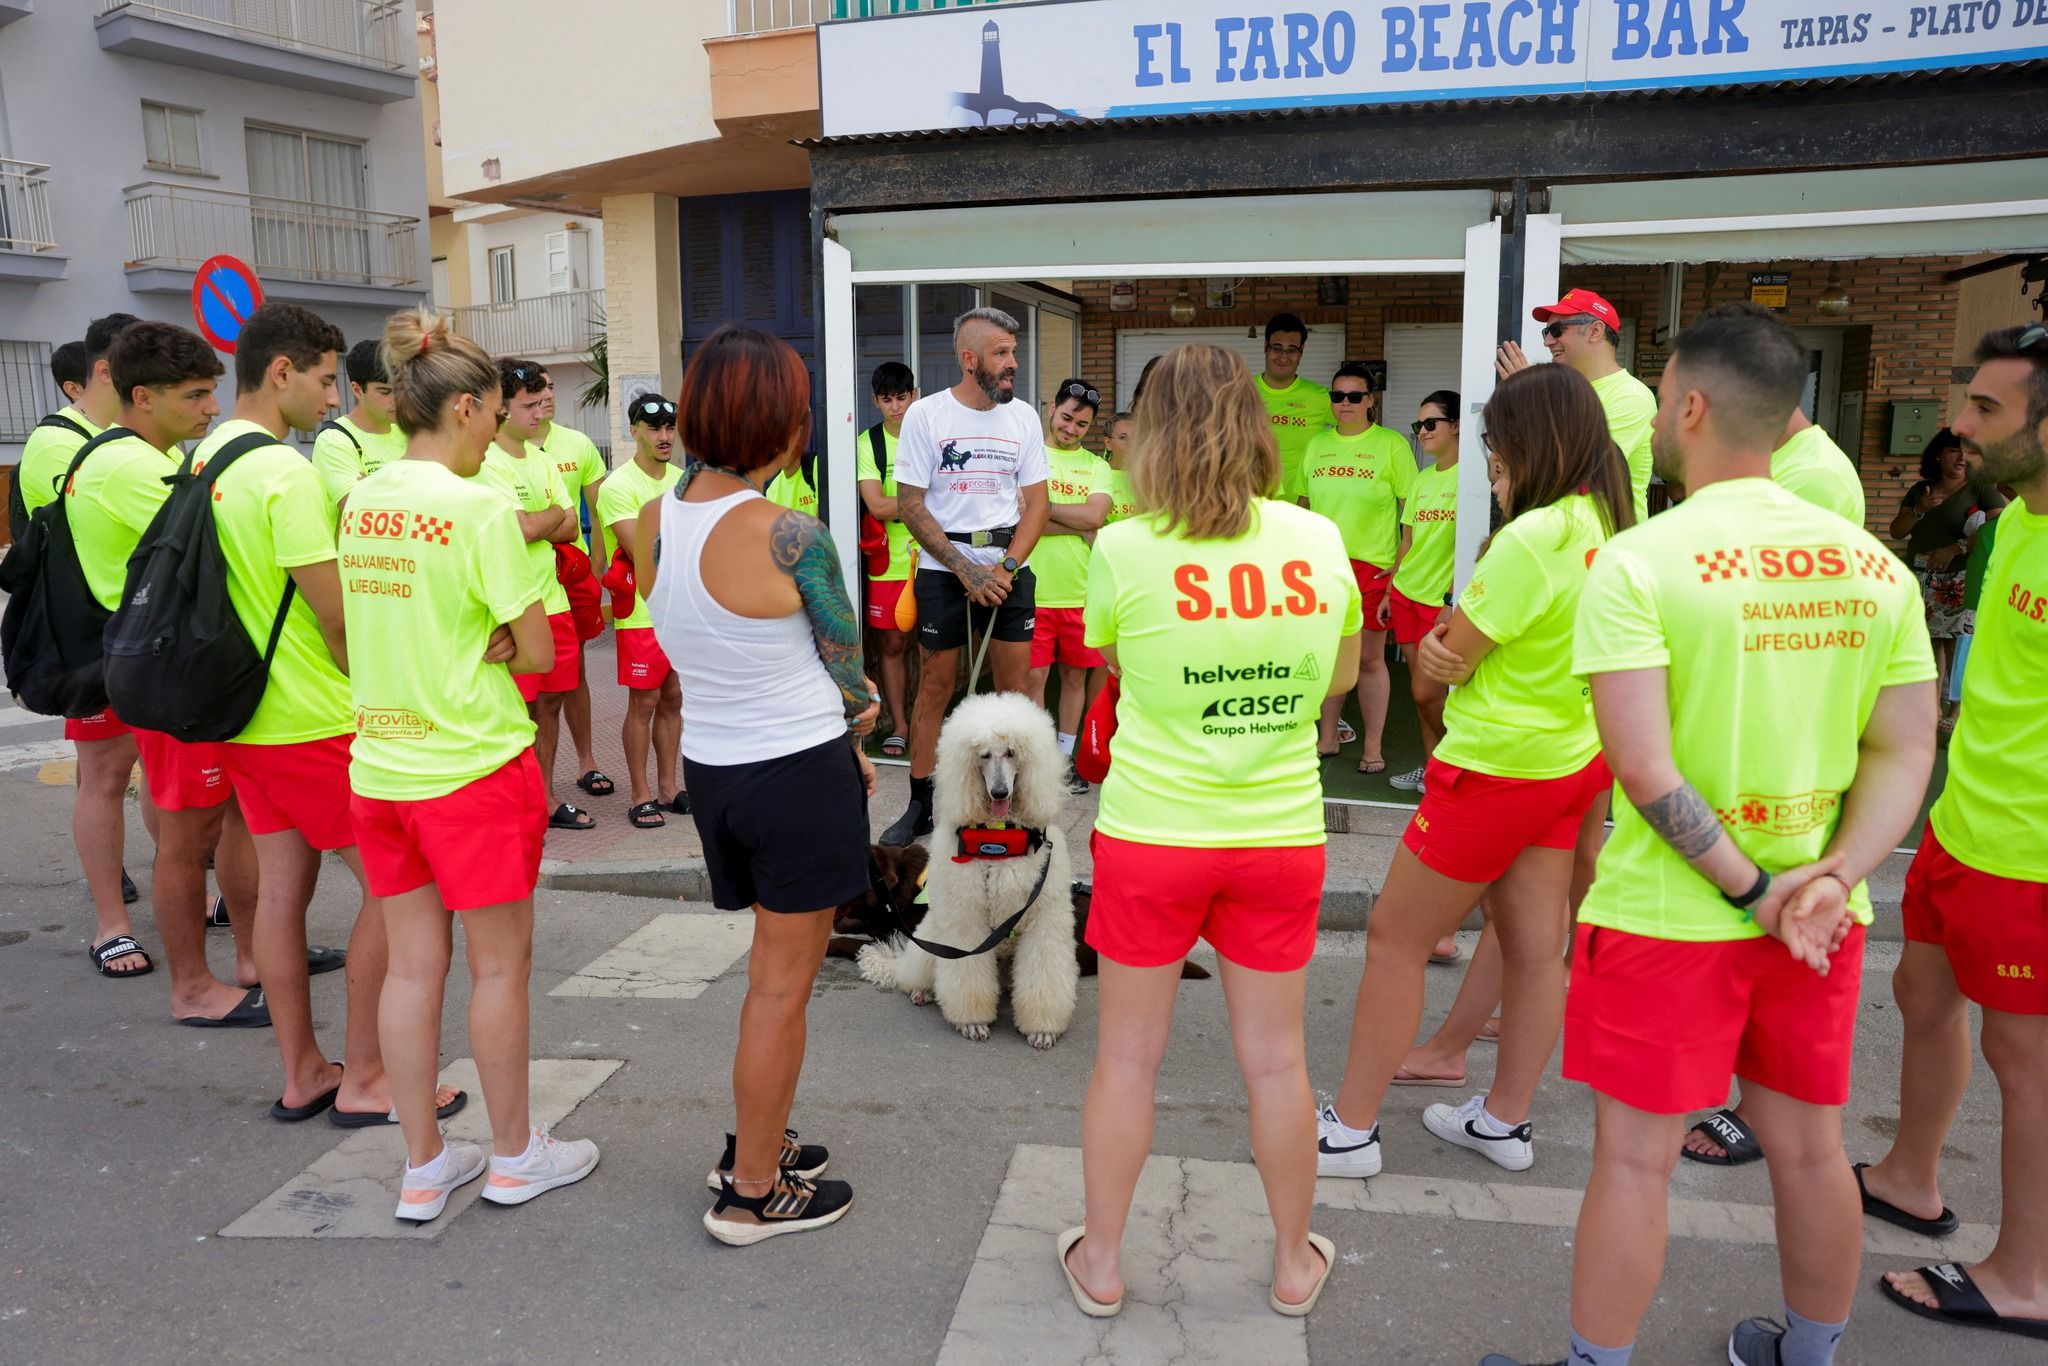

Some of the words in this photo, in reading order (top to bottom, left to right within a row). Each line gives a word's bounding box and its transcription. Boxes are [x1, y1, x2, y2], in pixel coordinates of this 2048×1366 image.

[1780, 13, 1872, 50] TAPAS
[1908, 0, 2001, 38] PLATO
[1215, 10, 1356, 83] FARO
[1381, 0, 1580, 73] BEACH
[1612, 0, 1749, 61] BAR
[1271, 415, 1289, 425] OS
[1328, 466, 1355, 477] SOS
[359, 511, 405, 537] SOS
[1418, 509, 1440, 521] SOS
[343, 554, 416, 574] SALVAMENTO
[1759, 548, 1846, 578] SOS
[349, 578, 413, 599] LIFEGUARD
[1174, 560, 1328, 621] S.O.S.
[1743, 599, 1877, 620] SALVAMENTO
[1744, 630, 1866, 652] LIFEGUARD
[1183, 661, 1291, 685] helvetia
[1222, 694, 1304, 717] caser
[1202, 724, 1246, 737] Grupo
[1250, 721, 1298, 734] Helvetia
[1997, 964, 2035, 979] S.O.S.
[1706, 1115, 1744, 1144] ANS
